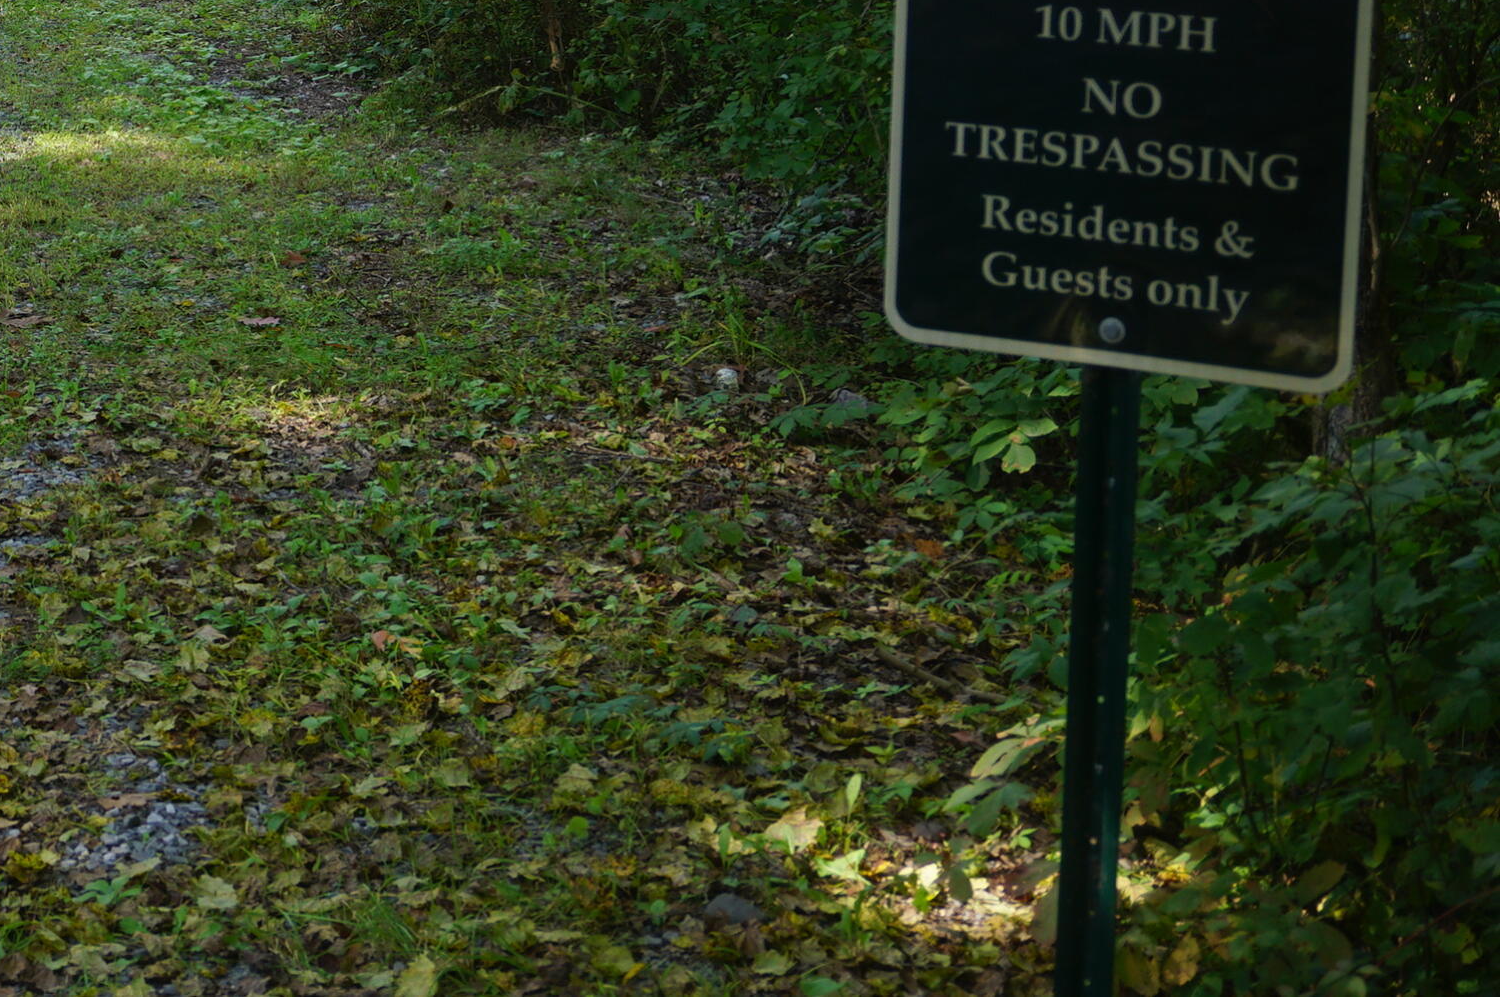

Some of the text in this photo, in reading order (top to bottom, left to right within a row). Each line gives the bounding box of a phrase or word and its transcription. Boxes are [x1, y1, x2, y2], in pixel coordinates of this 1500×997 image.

[1034, 4, 1218, 53] 10 MPH
[1081, 77, 1162, 119] NO
[944, 121, 1300, 192] TRESPASSING
[980, 194, 1255, 258] Residents &
[981, 250, 1250, 325] Guests only
